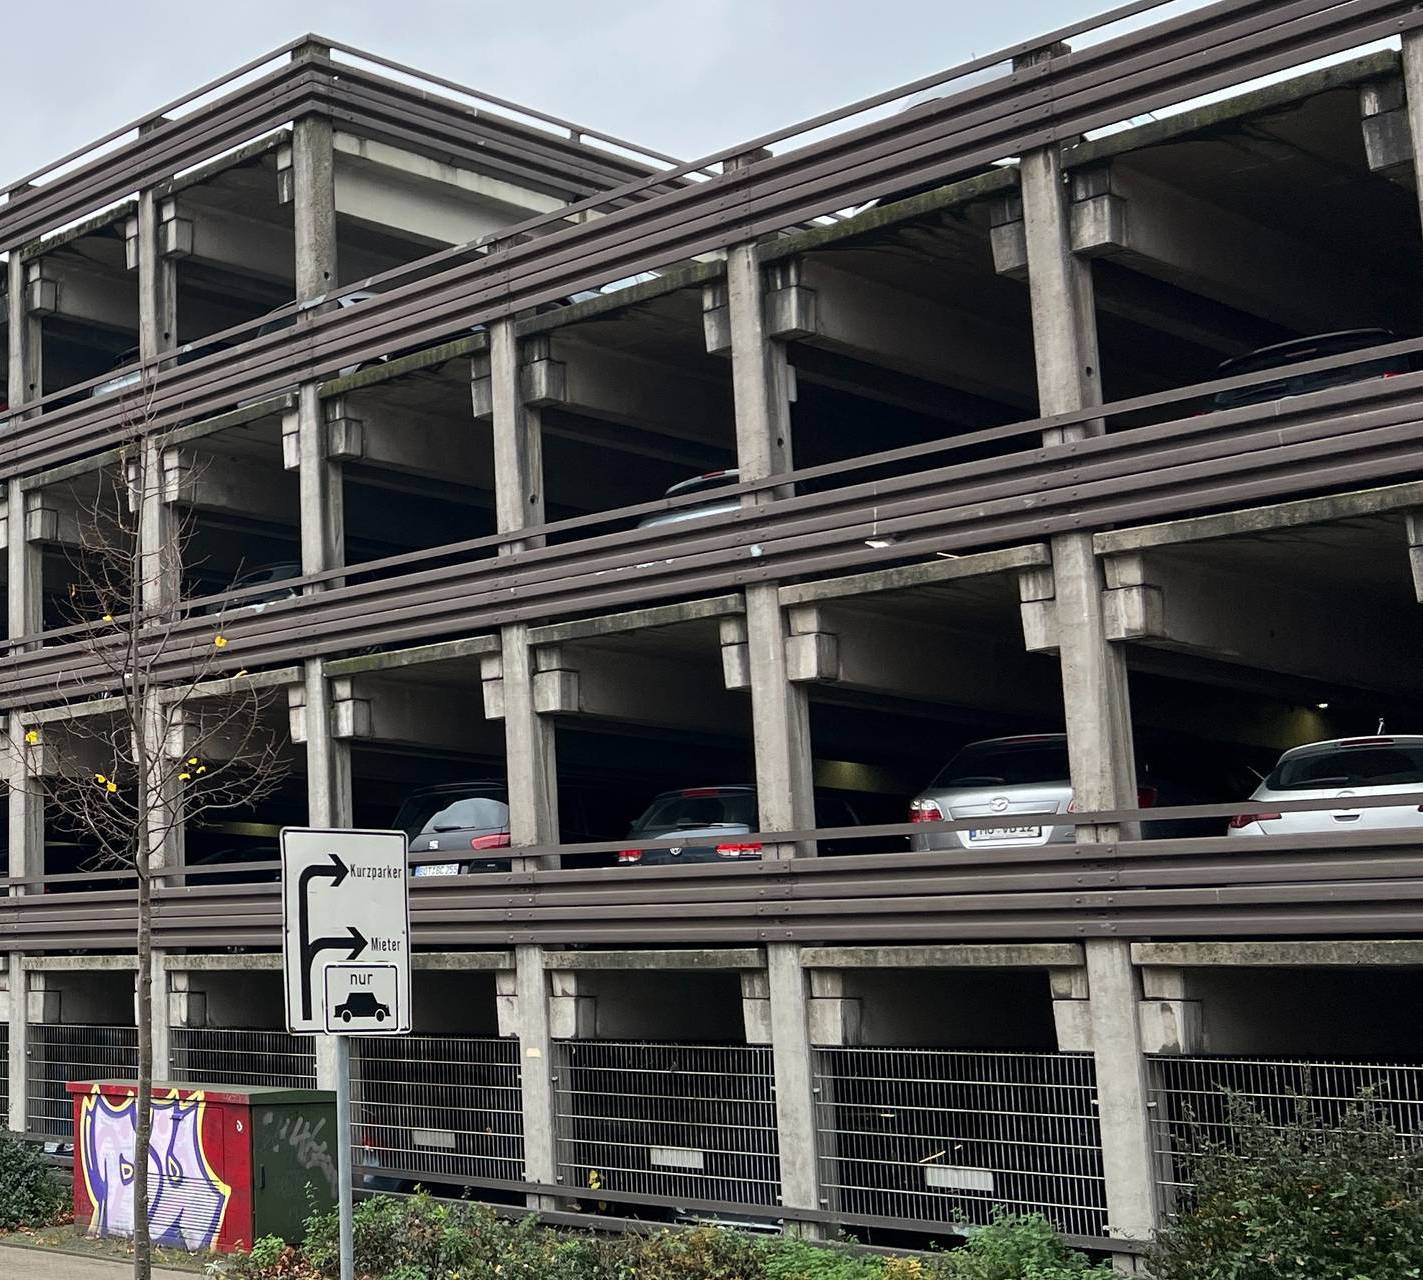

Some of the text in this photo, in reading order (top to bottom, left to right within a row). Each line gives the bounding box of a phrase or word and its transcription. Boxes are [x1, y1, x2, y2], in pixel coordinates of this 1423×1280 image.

[350, 864, 402, 880] Kurzparker
[371, 937, 401, 951] Mieter
[350, 973, 373, 985] nur
